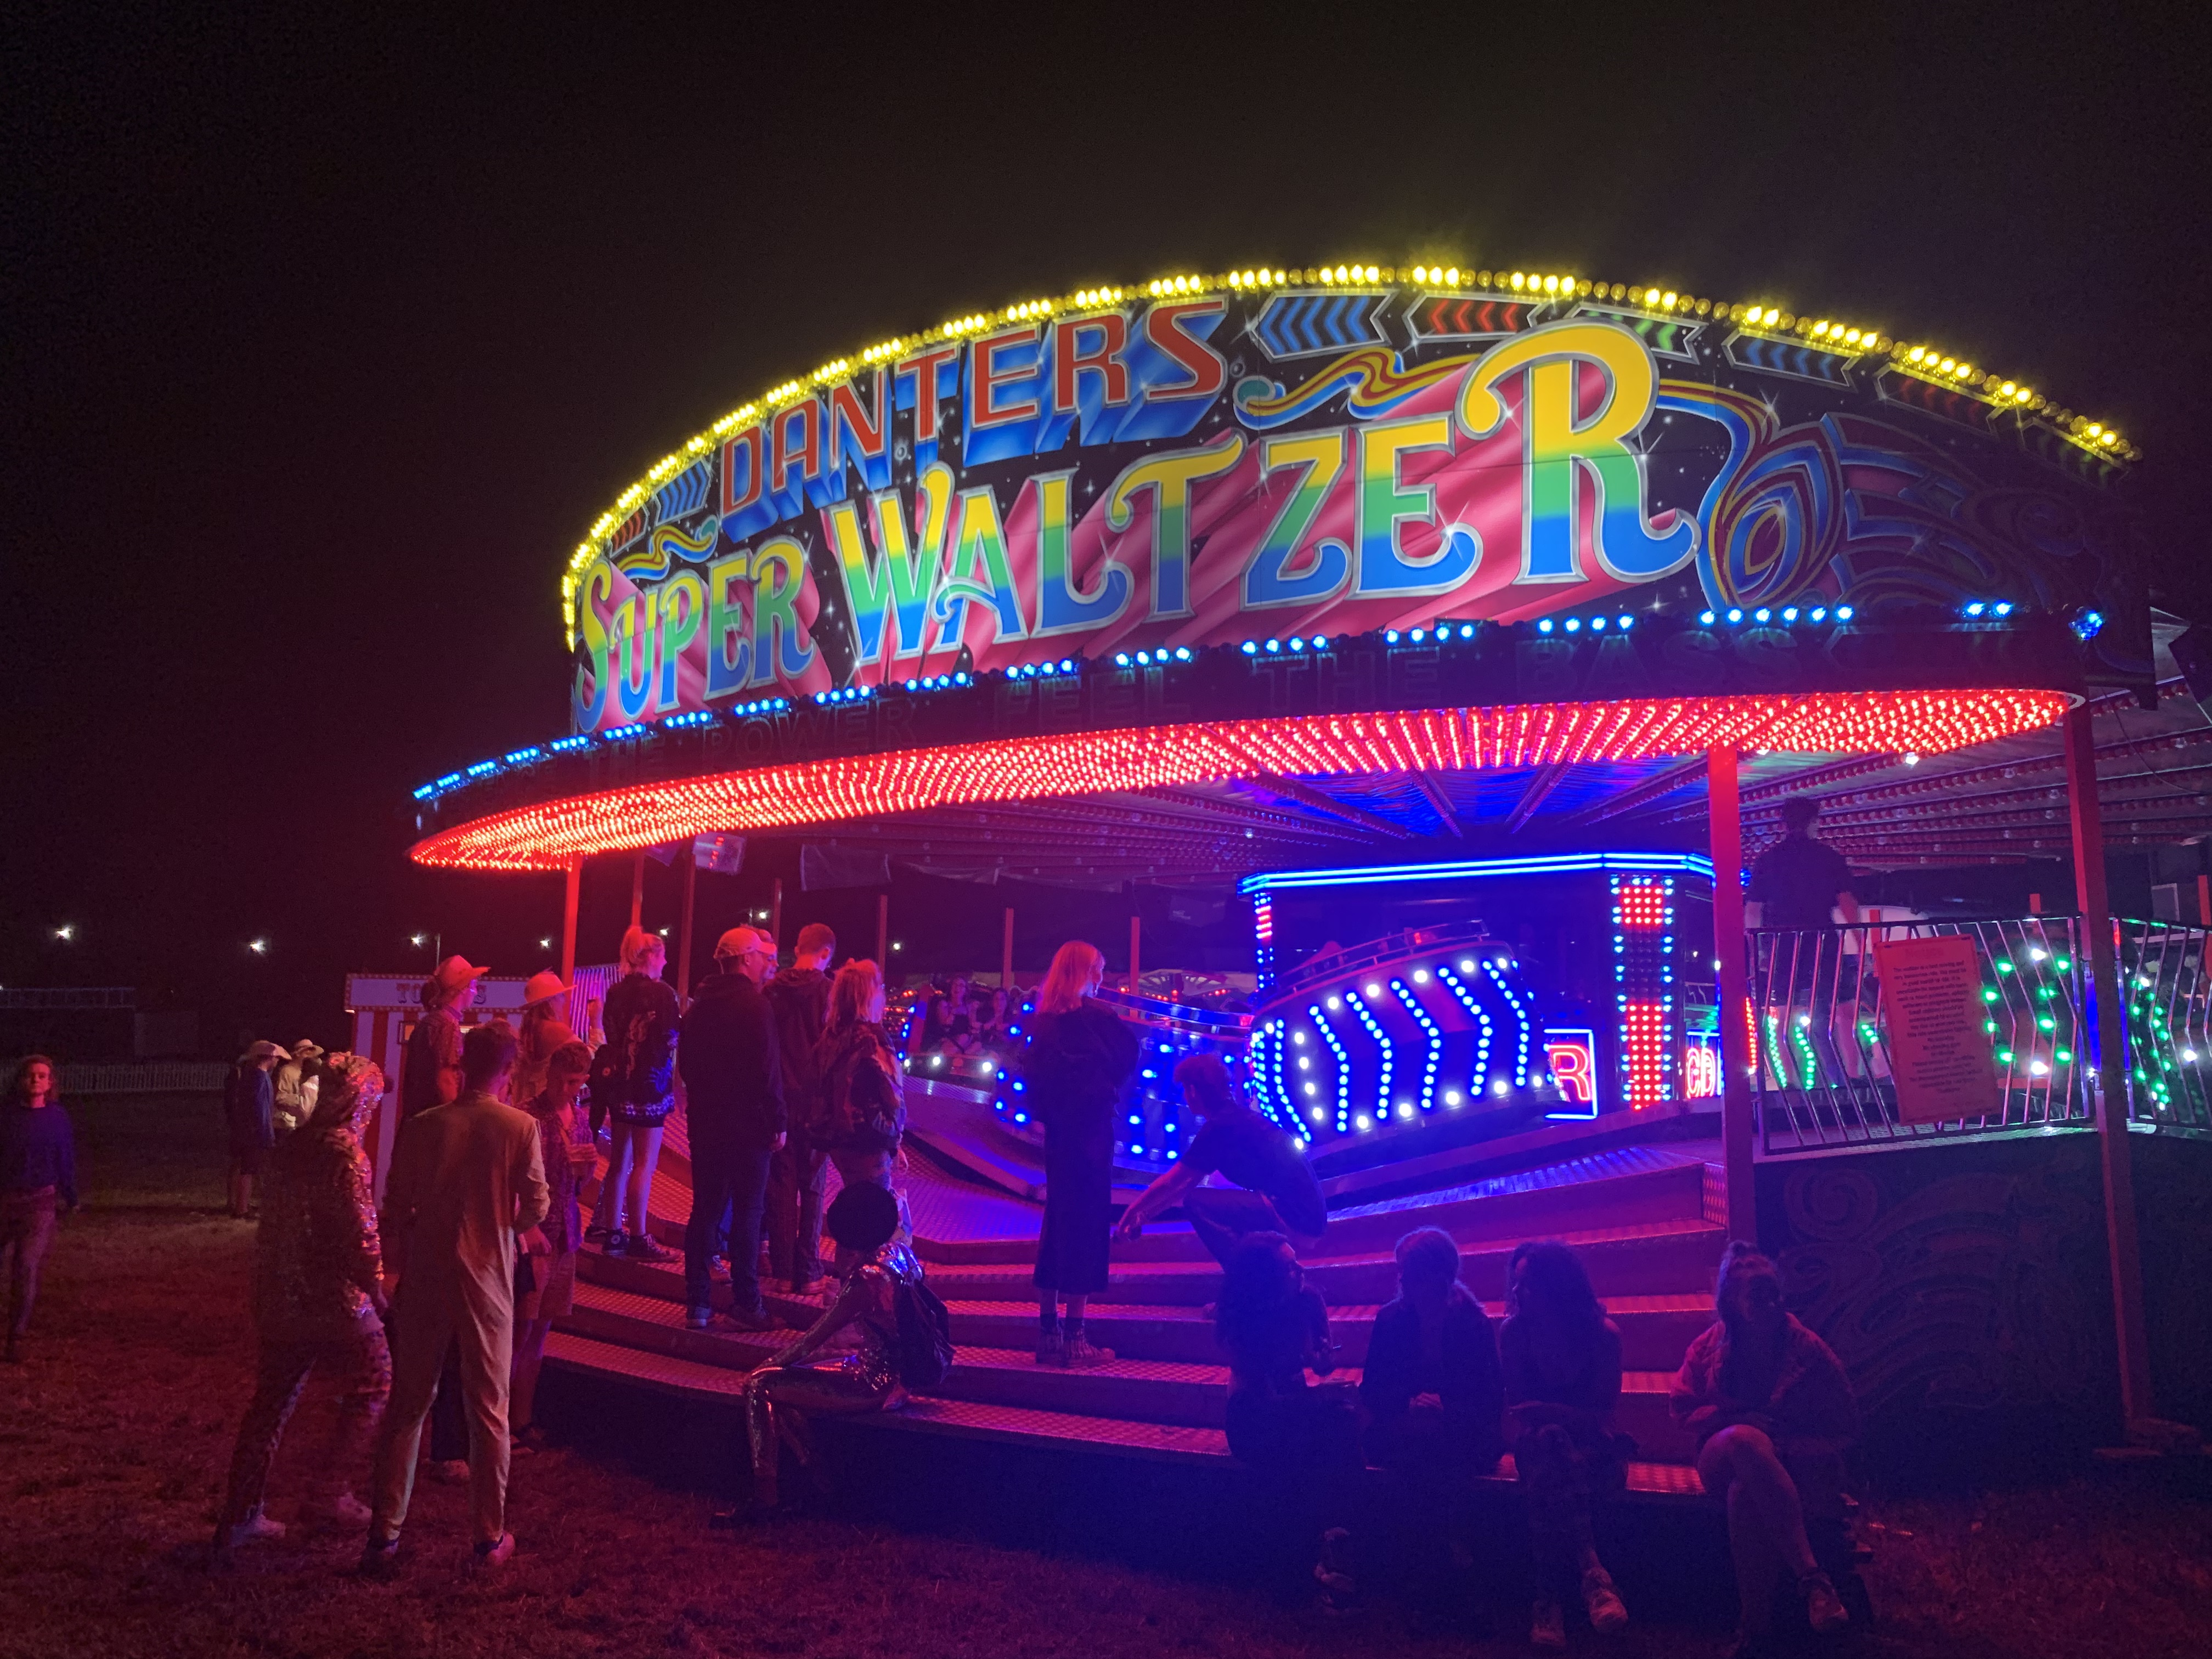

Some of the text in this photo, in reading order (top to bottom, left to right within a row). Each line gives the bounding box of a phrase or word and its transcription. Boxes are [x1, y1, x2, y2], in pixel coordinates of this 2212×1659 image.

[721, 295, 1229, 518] DANTERS
[575, 316, 1702, 732] SUPER WALTZER
[702, 697, 917, 770] POWER
[994, 665, 1192, 734] FEEL
[1252, 646, 1441, 712] THE
[1515, 627, 1802, 697] BASS
